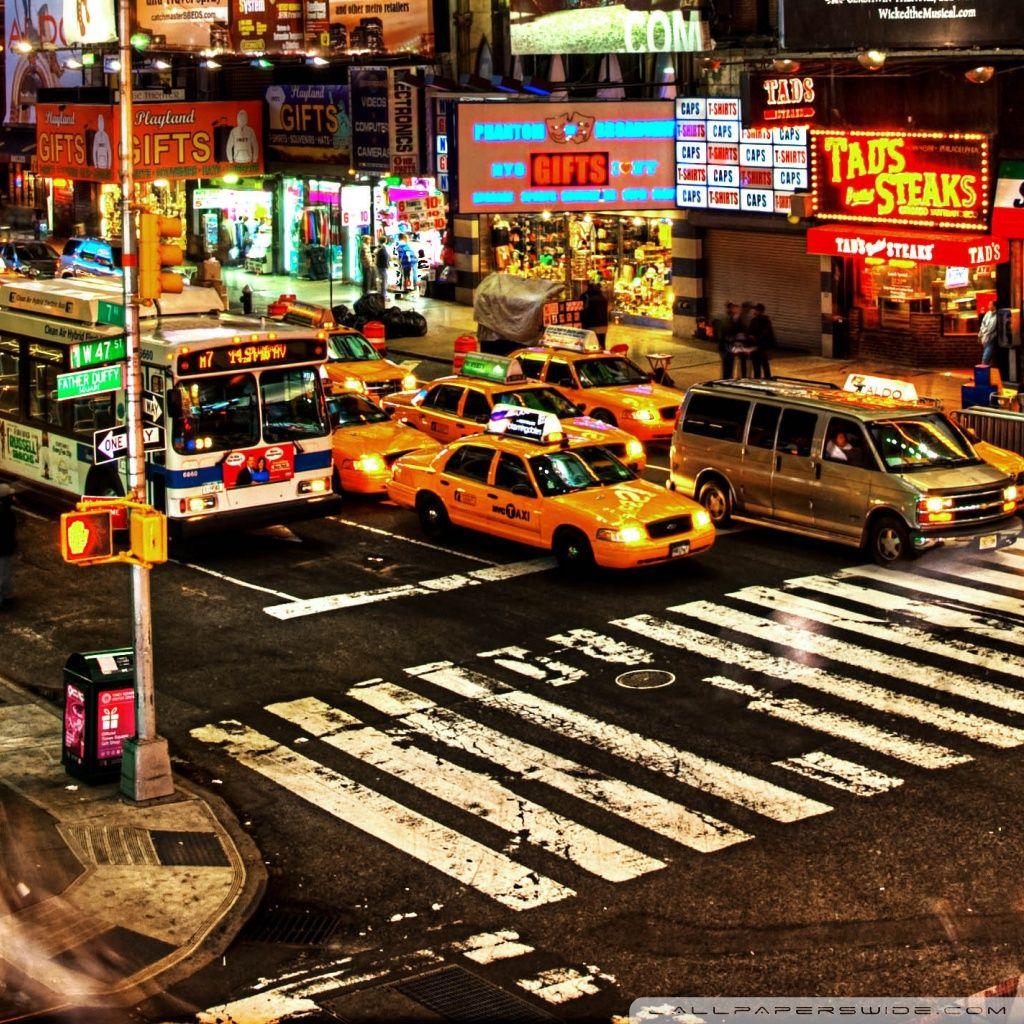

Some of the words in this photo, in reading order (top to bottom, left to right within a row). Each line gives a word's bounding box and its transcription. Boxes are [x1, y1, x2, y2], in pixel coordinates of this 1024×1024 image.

[336, 6, 346, 15] and
[348, 5, 363, 14] other
[365, 4, 383, 13] metro
[878, 6, 977, 19] WickedtheMusical.com
[361, 97, 387, 108] VIDEOS
[681, 102, 700, 115] CAPS
[708, 103, 737, 115] T-SHIRTS
[135, 109, 195, 127] Playland
[280, 104, 338, 133] GIFTS
[677, 124, 705, 138] T-SHIRTS
[713, 125, 732, 138] CAPS
[779, 128, 800, 141] CAPS
[40, 133, 85, 164] GIFTS
[682, 146, 700, 159] CAPS
[709, 147, 737, 161] T-SHIRTS
[746, 148, 766, 162] CAPS
[775, 150, 806, 164] T-SHIRTS
[534, 154, 607, 185] GIFTS
[678, 168, 706, 182] T-SHIRTS
[714, 169, 733, 183] CAPS
[742, 171, 772, 186] T-SHIRTS
[780, 171, 801, 185] CAPS
[682, 190, 701, 203] CAPS
[709, 191, 738, 205] T-SHIRTS
[747, 193, 767, 207] CAPS
[876, 172, 977, 216] STEAKS
[968, 243, 1001, 264] TAD'S
[44, 325, 58, 337] Clean
[59, 328, 67, 338] Air
[68, 329, 84, 342] Hybrid
[83, 345, 93, 364] W
[96, 341, 110, 361] 47
[58, 372, 89, 390] FATHER
[92, 368, 120, 384] DUFFY
[867, 386, 902, 399] ALDO
[105, 436, 123, 451] ONE
